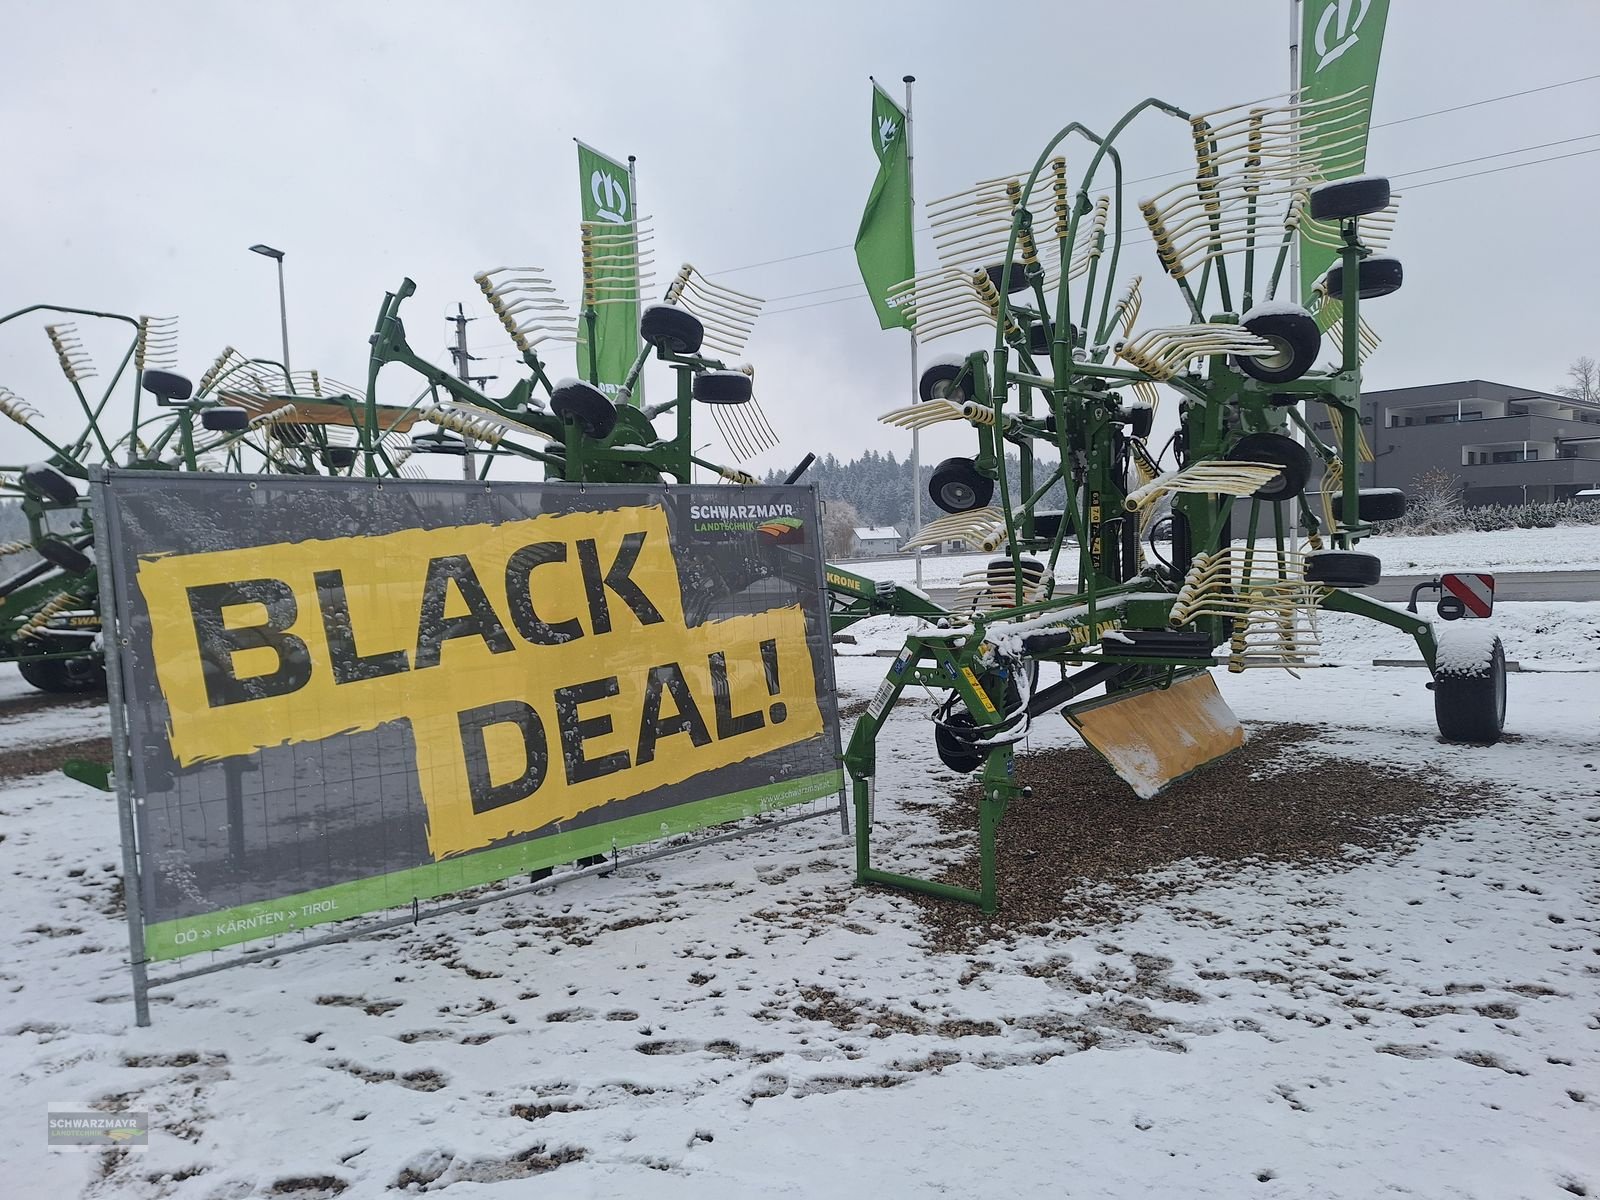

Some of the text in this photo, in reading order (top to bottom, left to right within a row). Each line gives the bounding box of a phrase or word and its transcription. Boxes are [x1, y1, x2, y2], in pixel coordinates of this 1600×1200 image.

[691, 505, 793, 519] SCHWARZMAYR
[694, 522, 755, 532] LANDTECHNIK
[826, 572, 861, 590] KRONE
[185, 531, 664, 708] BLACK
[456, 640, 787, 815] DEAL!
[174, 930, 198, 944] OÖ
[216, 910, 284, 936] KÄRNTEN
[302, 900, 339, 916] TIROL
